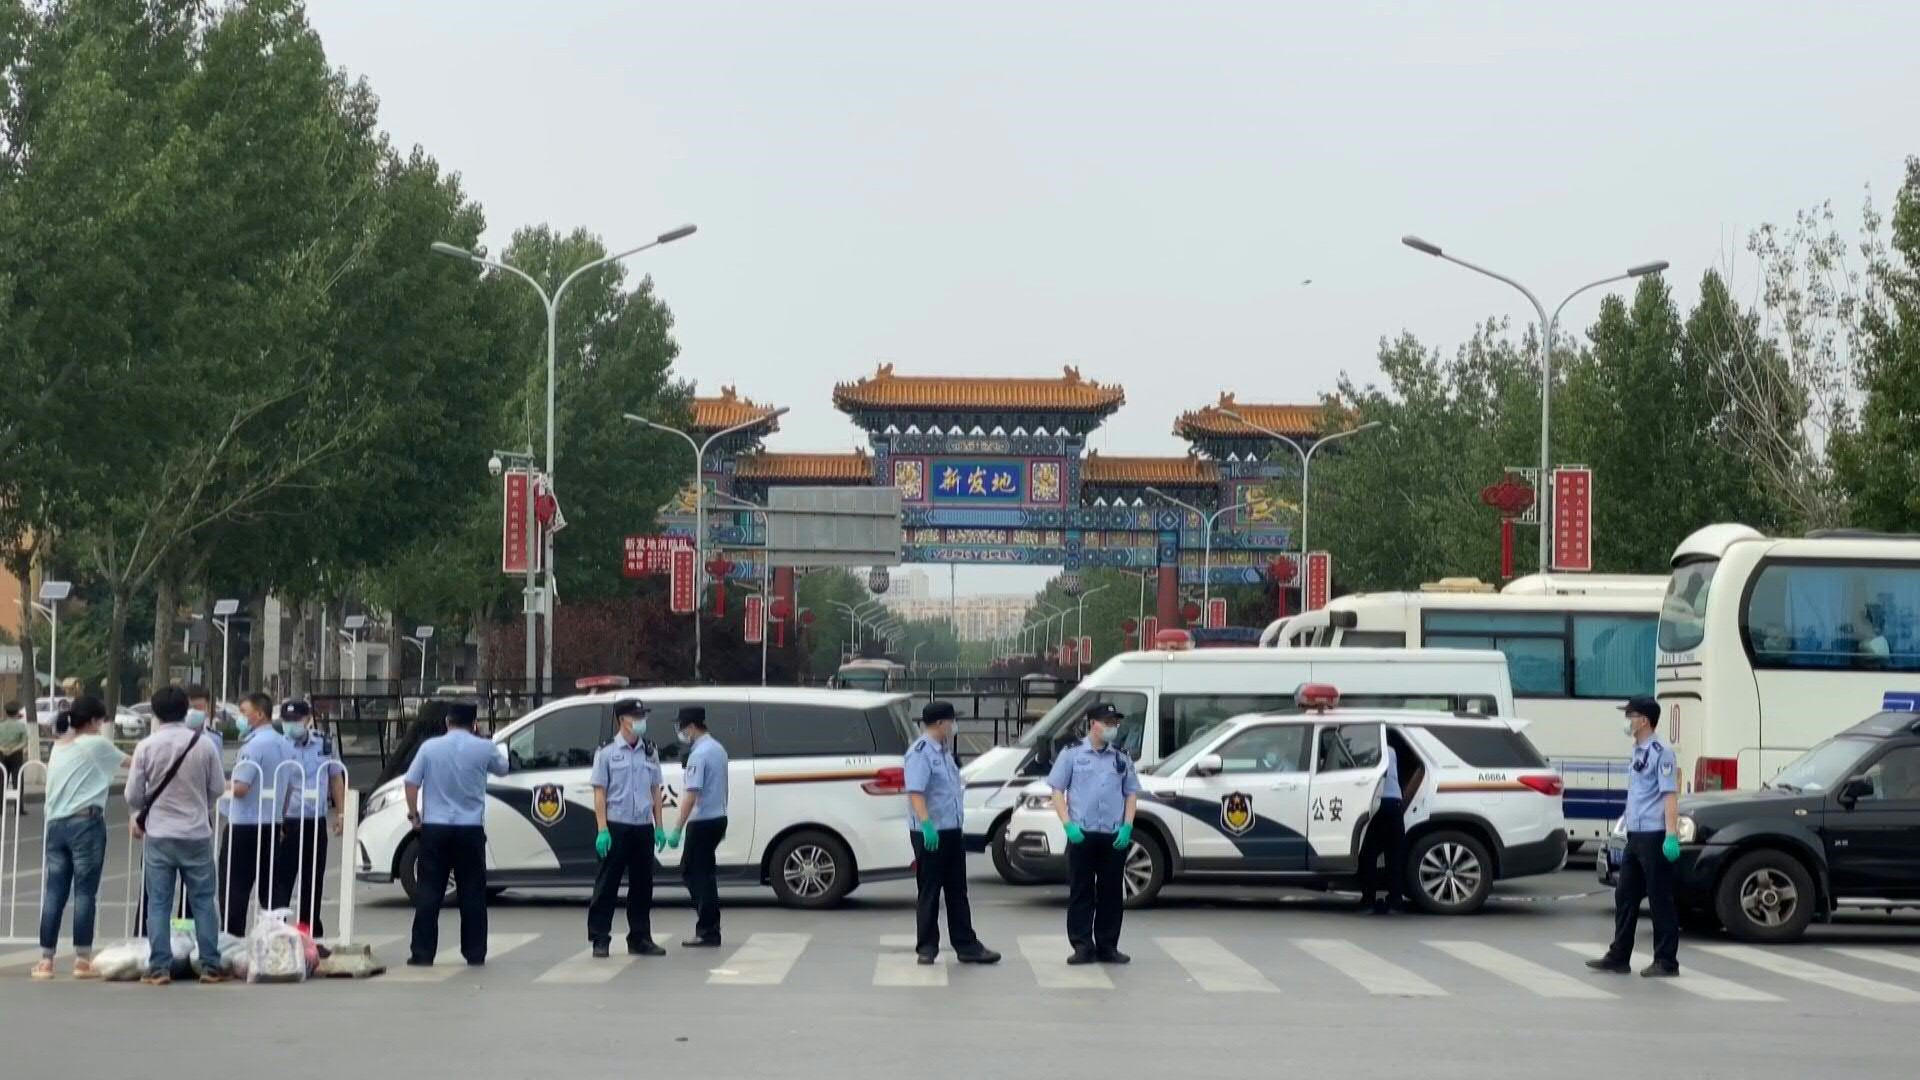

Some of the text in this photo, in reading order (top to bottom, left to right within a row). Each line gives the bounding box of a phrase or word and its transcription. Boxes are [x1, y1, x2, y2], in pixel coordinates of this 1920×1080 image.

[938, 466, 1016, 496] 新发地
[660, 784, 679, 808] 公
[1311, 796, 1343, 821] 公安
